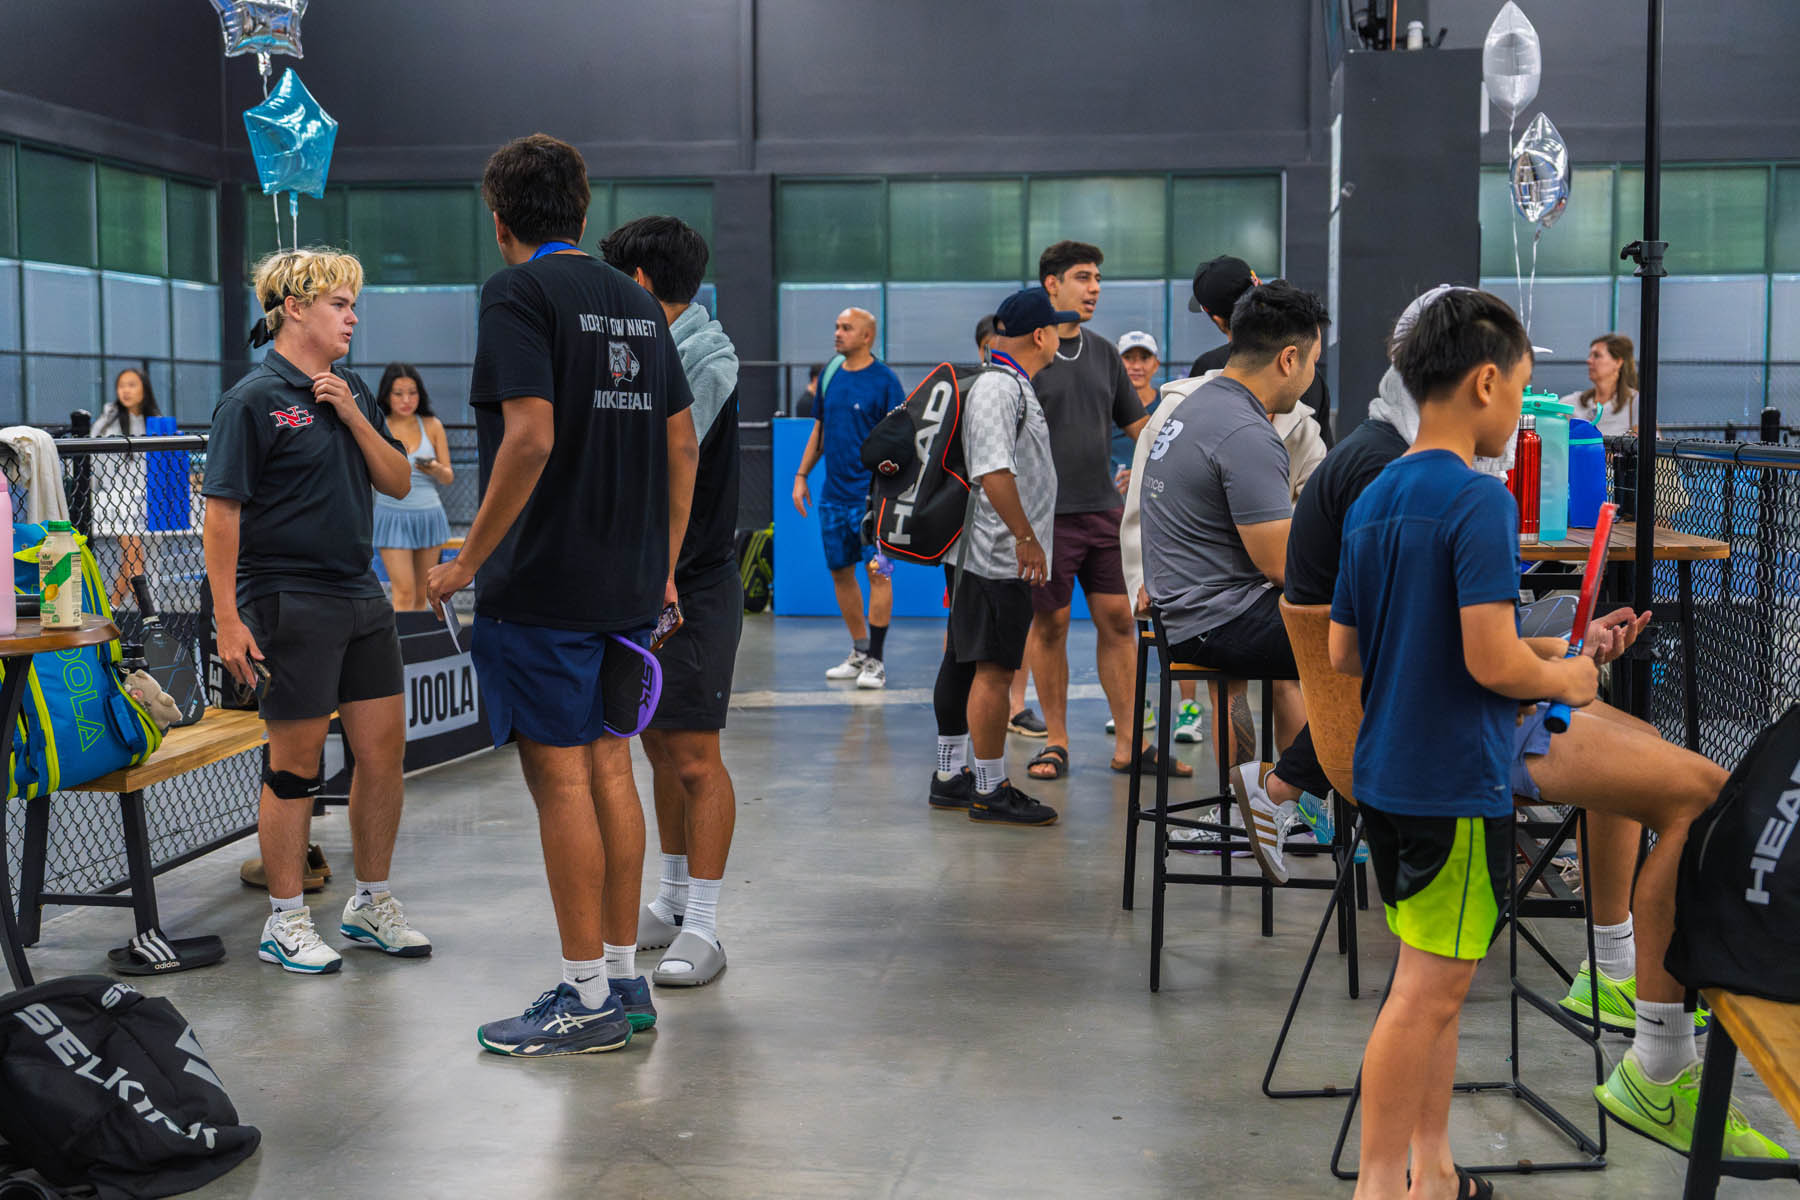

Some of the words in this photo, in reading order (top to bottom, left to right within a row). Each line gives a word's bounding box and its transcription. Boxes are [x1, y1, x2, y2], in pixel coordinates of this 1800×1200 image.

[610, 318, 657, 338] GWNNETT
[409, 665, 475, 728] JOOLA
[1745, 760, 1800, 905] HEA
